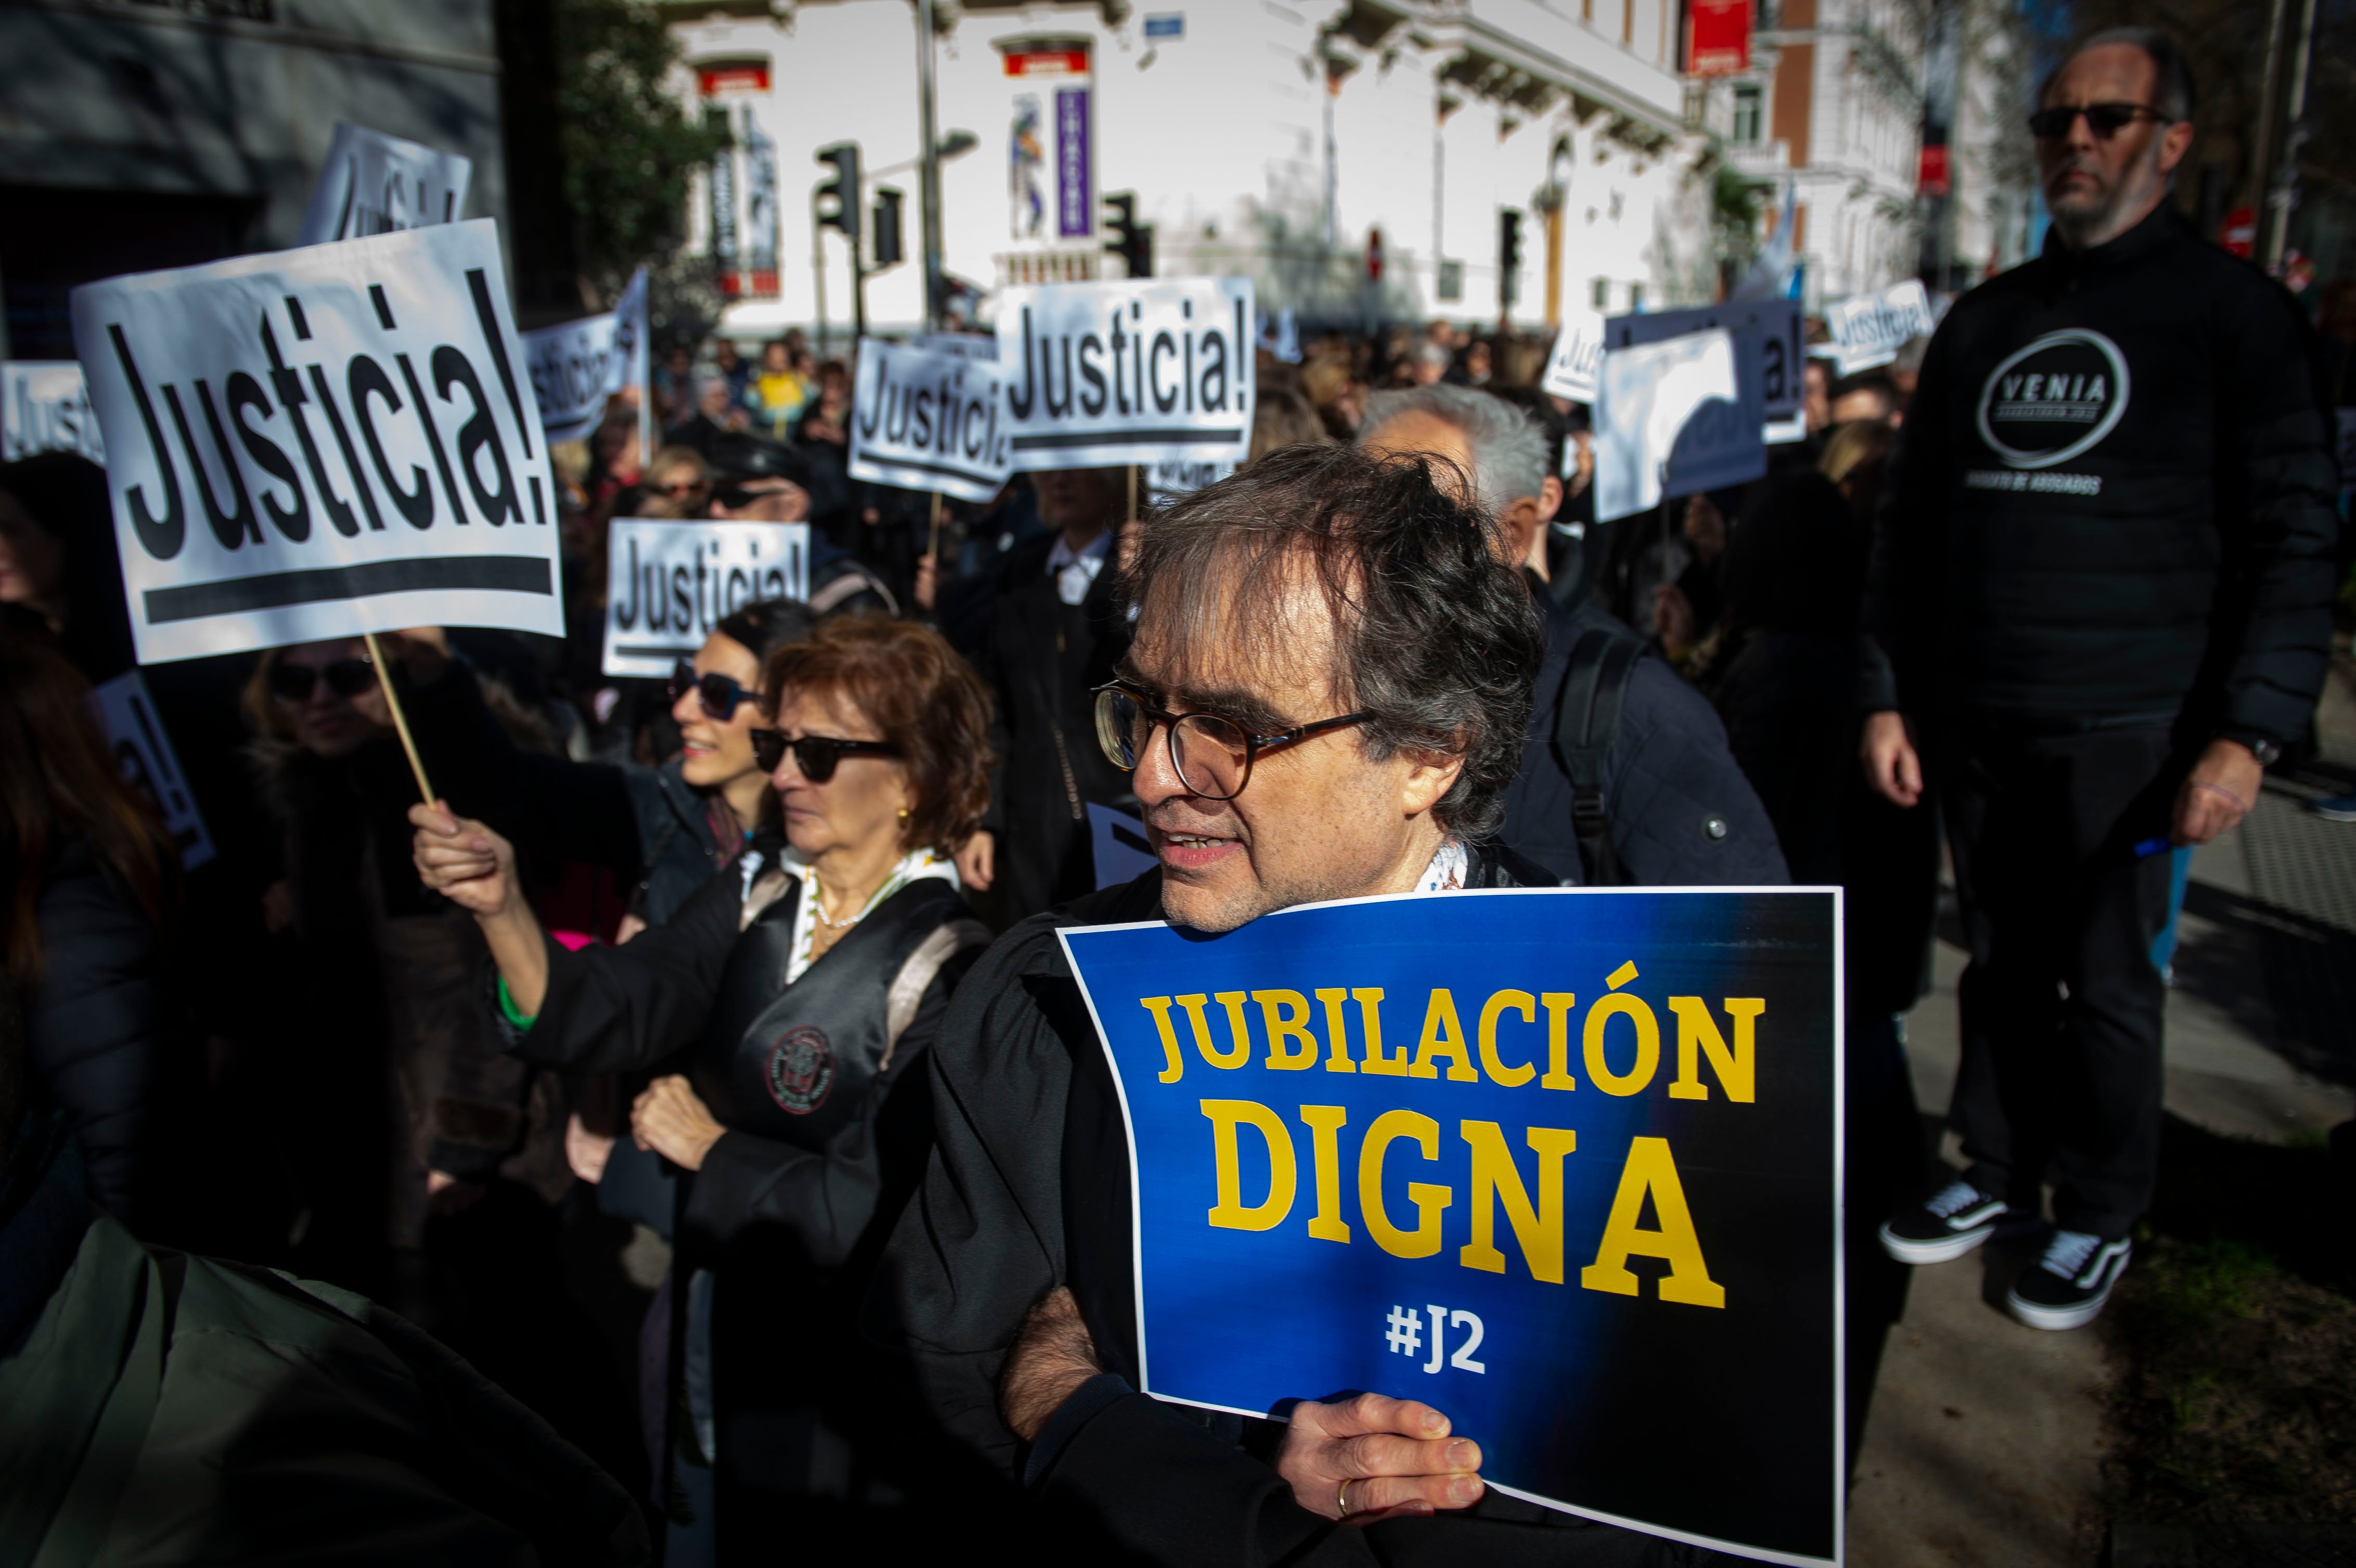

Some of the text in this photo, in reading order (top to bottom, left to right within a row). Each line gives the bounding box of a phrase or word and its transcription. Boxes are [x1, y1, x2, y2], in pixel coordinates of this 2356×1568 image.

[107, 267, 547, 560] Justicia!
[860, 356, 1005, 466] Justici
[1007, 298, 1246, 419] Justicia!
[2002, 372, 2106, 403] VENIA
[1139, 959, 1766, 1103] JUBILACIÓN
[1199, 1098, 1726, 1309] DIGNA
[1385, 1303, 1487, 1376] #J2
